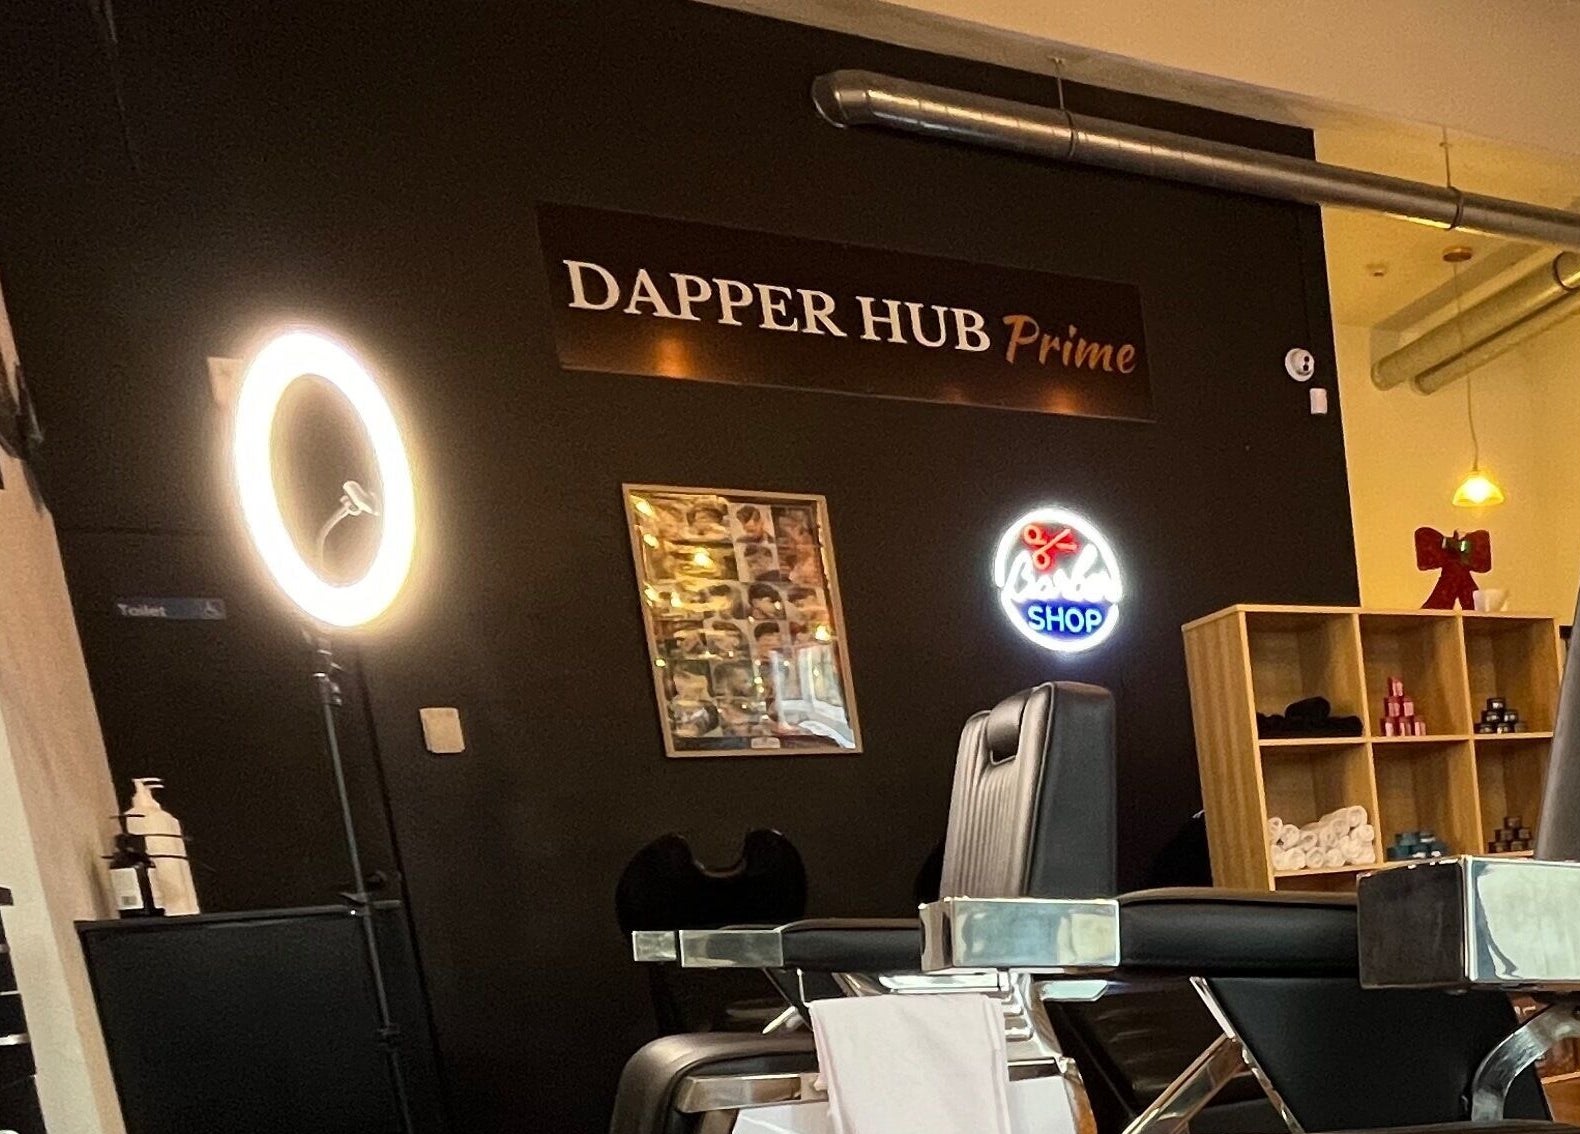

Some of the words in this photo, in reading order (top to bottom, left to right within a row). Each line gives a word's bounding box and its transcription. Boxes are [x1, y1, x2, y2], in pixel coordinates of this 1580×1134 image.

[563, 259, 848, 338] DAPPER
[855, 295, 991, 352] HUB
[1002, 313, 1138, 375] Prime
[1027, 604, 1103, 634] SHOP
